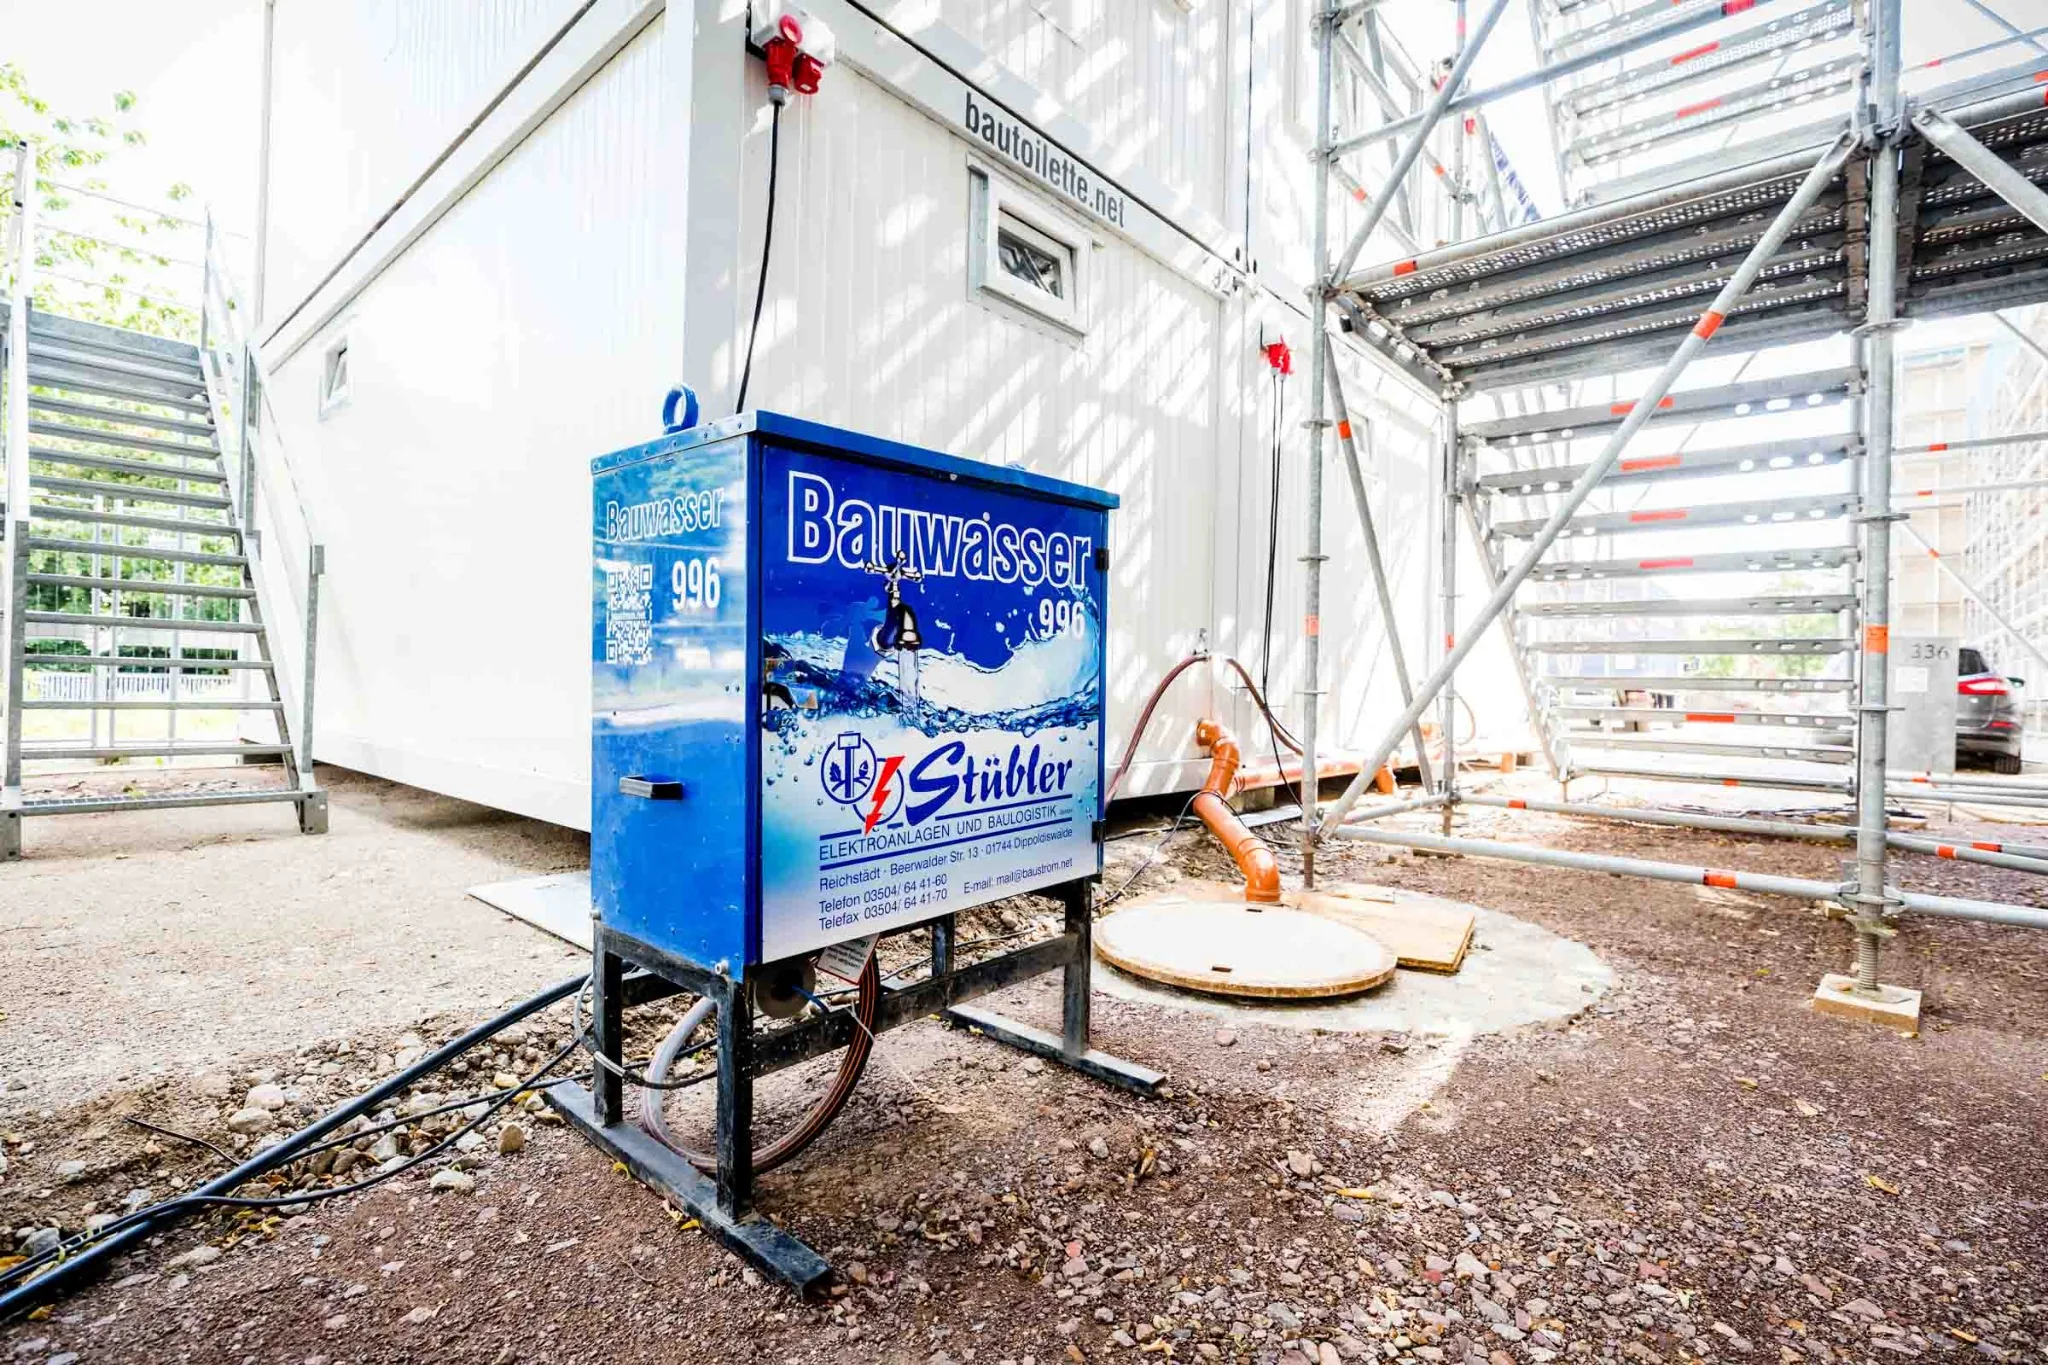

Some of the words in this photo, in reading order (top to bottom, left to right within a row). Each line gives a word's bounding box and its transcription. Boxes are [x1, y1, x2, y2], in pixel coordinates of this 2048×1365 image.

[965, 91, 1125, 228] bautoilette.net
[606, 487, 725, 544] Bauwasser
[788, 470, 1091, 589] Bauwasser
[672, 557, 721, 611] 996
[1039, 598, 1085, 640] 996
[1911, 644, 1949, 660] 336
[905, 740, 1073, 827] Stübler
[819, 825, 950, 861] ELEKTROANLAGEN
[957, 819, 982, 835] UND
[988, 805, 1057, 829] BAULOGISTIK
[819, 868, 881, 892] Reichstädt
[890, 854, 948, 876] Beerwalder
[950, 849, 965, 863] Str.
[968, 846, 978, 859] 13
[985, 840, 1011, 855] 01744
[1014, 828, 1073, 850] Dippoldiswalde
[819, 895, 860, 914] Telefon
[904, 881, 917, 893] 64
[919, 874, 948, 889] 41-60
[963, 876, 994, 894] E-mail:
[996, 858, 1073, 885] mail@baustrom.net
[819, 912, 860, 931] Telefax
[904, 896, 917, 910] 64
[919, 888, 948, 905] 41-70
